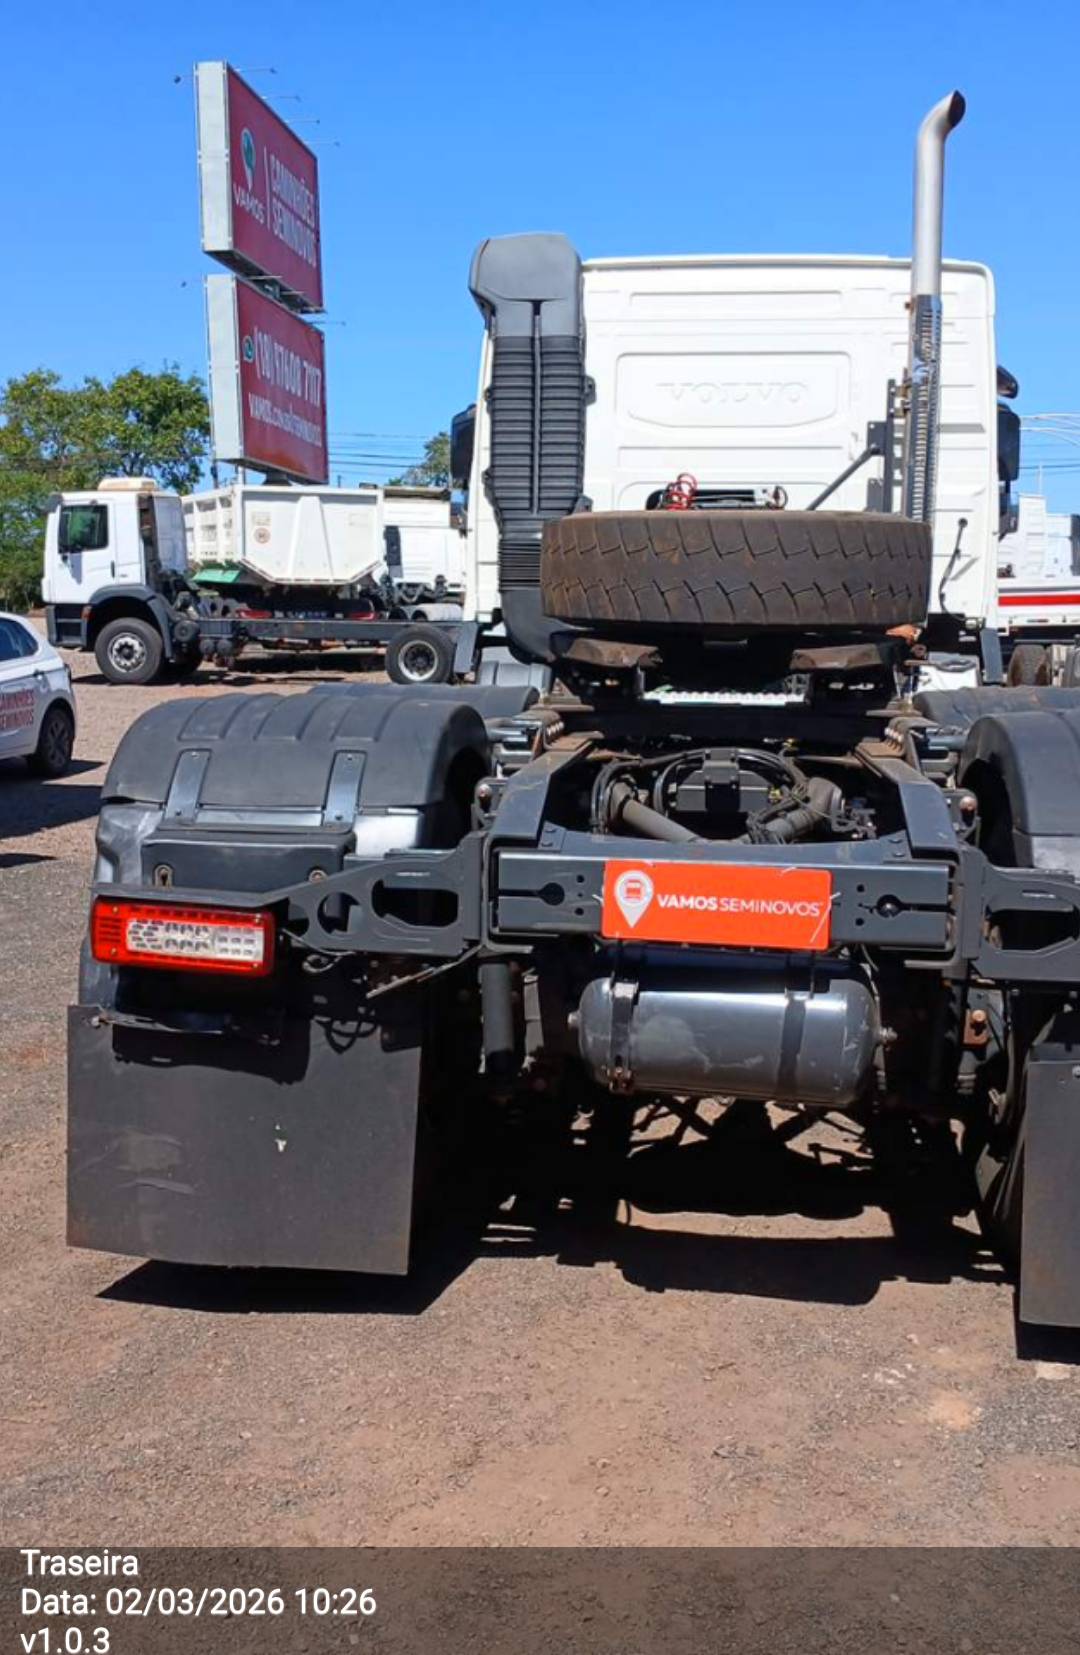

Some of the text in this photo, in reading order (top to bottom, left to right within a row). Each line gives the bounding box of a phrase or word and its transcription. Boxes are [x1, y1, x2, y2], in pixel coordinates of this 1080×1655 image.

[655, 381, 809, 403] VOLVO
[656, 893, 821, 918] VAMOS SEMINOVOS
